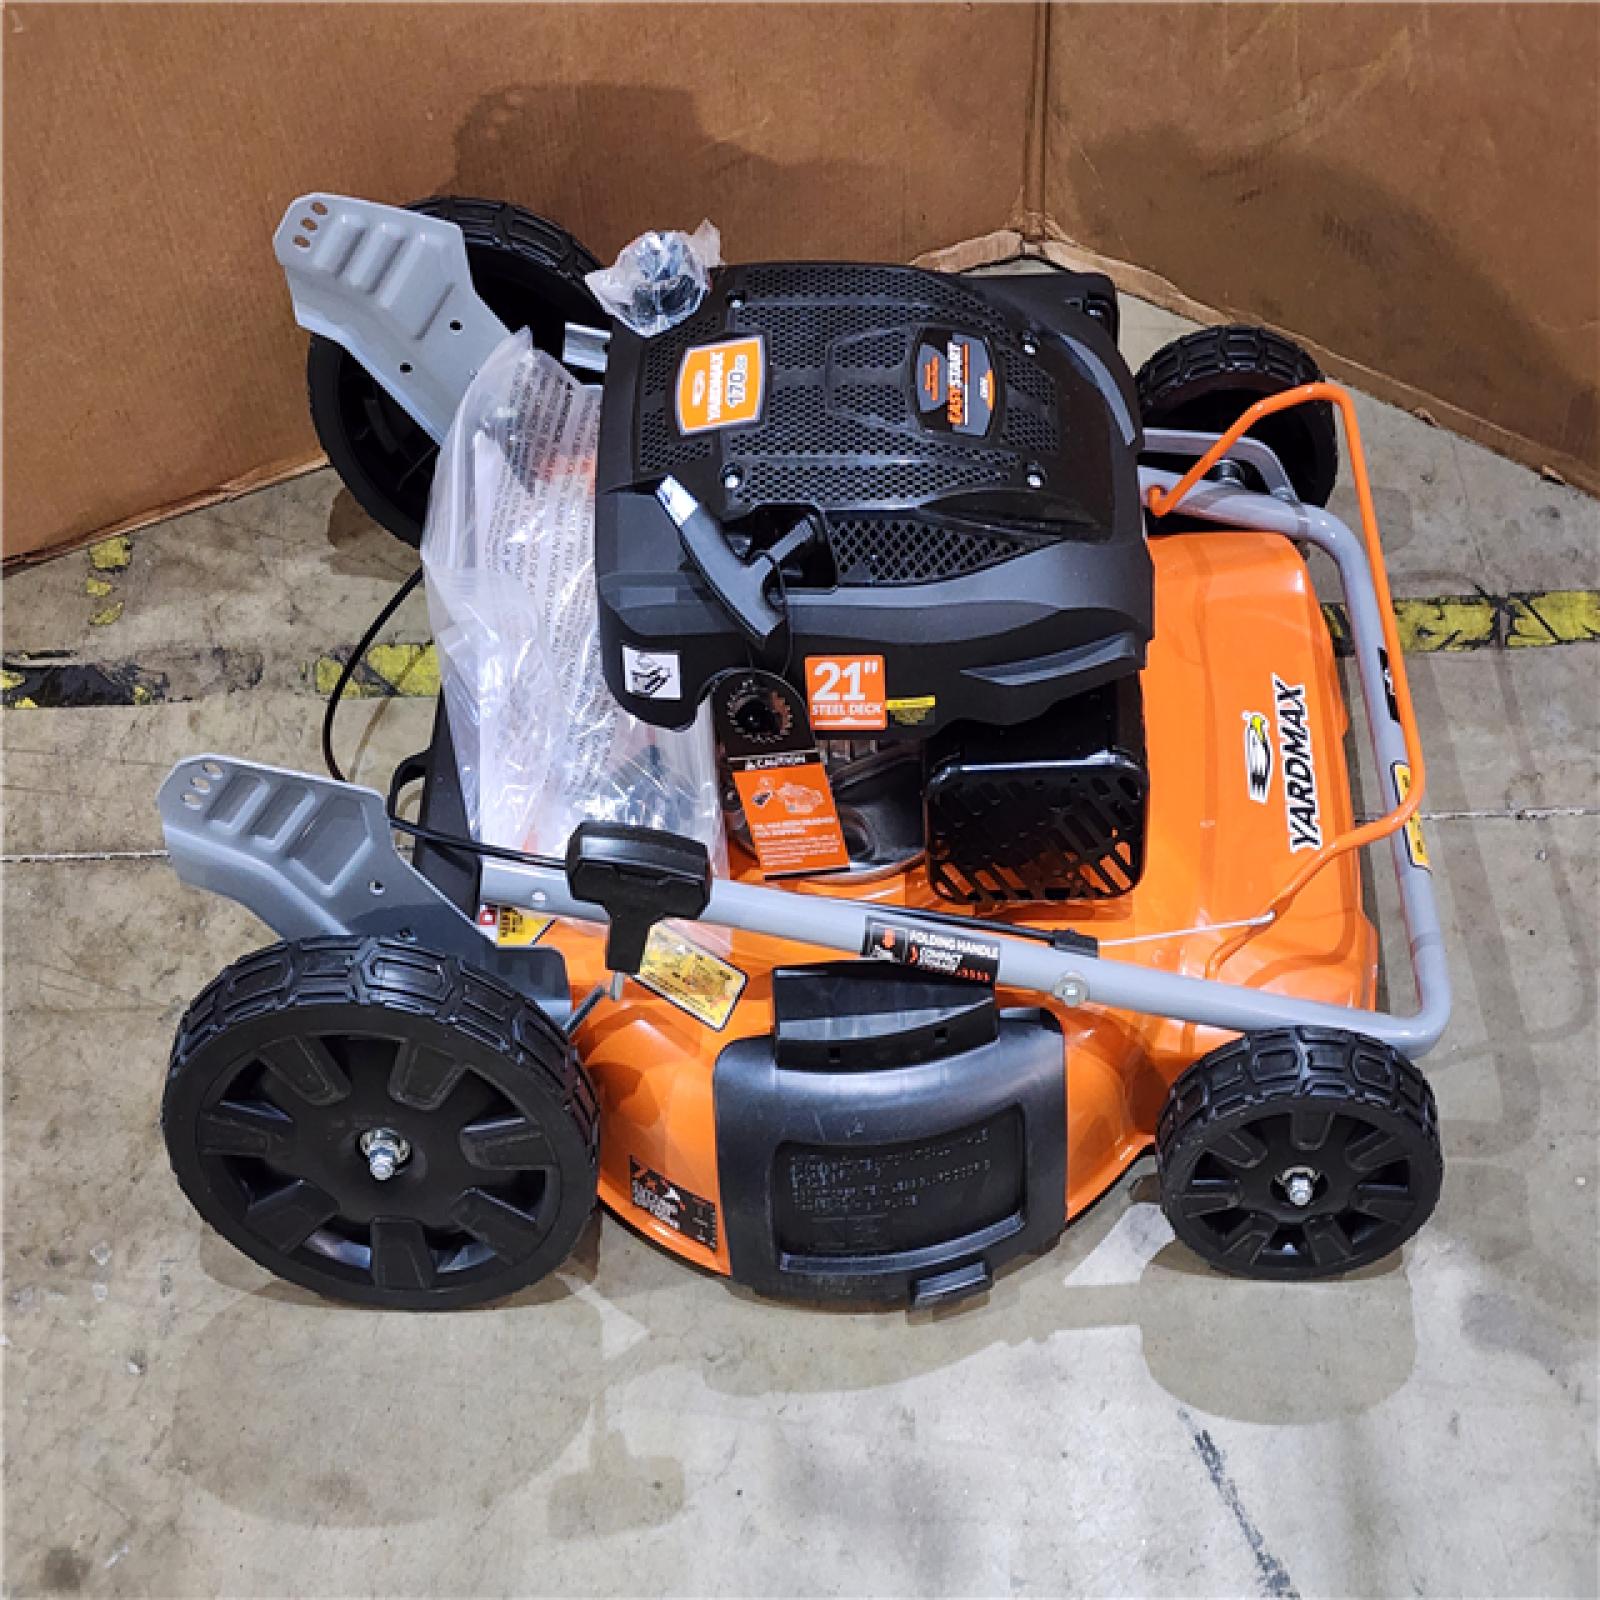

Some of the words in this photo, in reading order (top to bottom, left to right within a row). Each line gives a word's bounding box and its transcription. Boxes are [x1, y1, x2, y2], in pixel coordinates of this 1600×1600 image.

[812, 661, 879, 701] 21"
[812, 704, 846, 716] STEEL
[848, 703, 882, 715] DECK
[1272, 672, 1322, 853] YARDMAX
